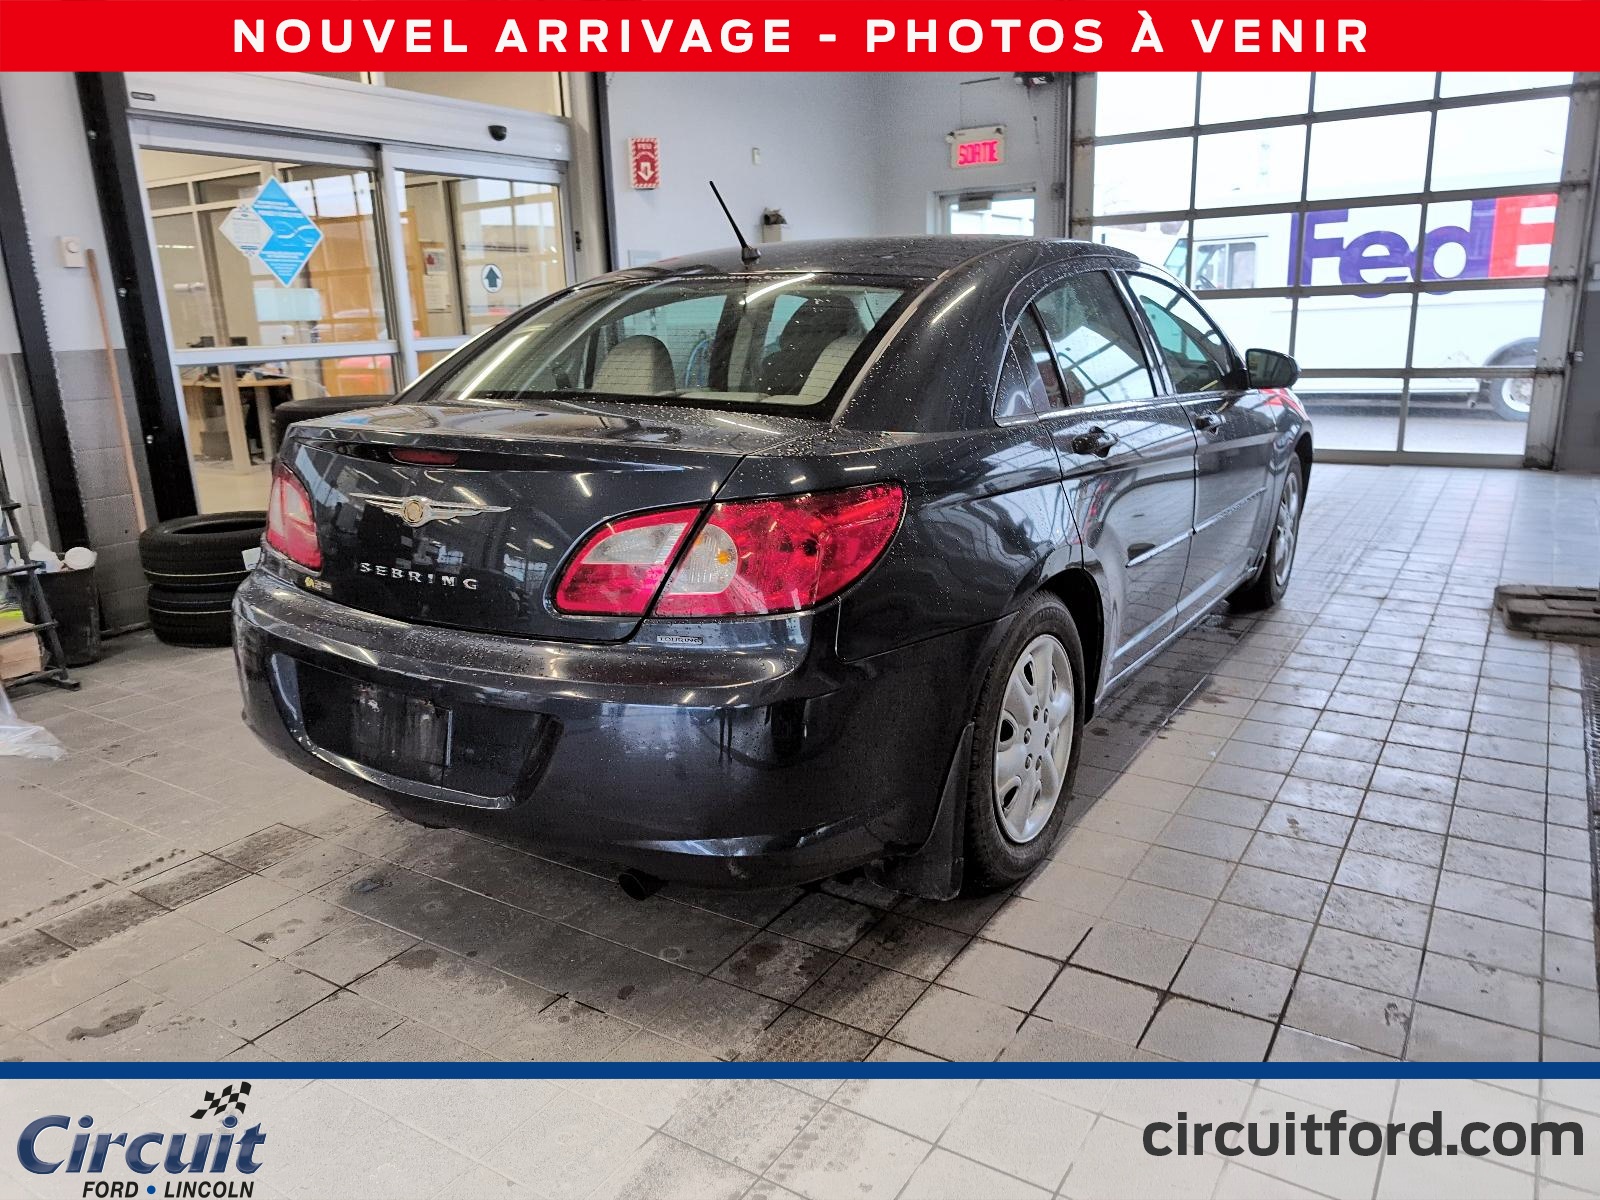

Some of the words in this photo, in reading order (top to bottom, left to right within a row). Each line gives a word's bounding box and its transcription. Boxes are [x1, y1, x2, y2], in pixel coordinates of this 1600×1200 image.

[958, 140, 998, 165] SORTIE
[1286, 193, 1558, 298] FedE
[360, 562, 478, 590] SEBRING
[658, 636, 703, 644] TOURING
